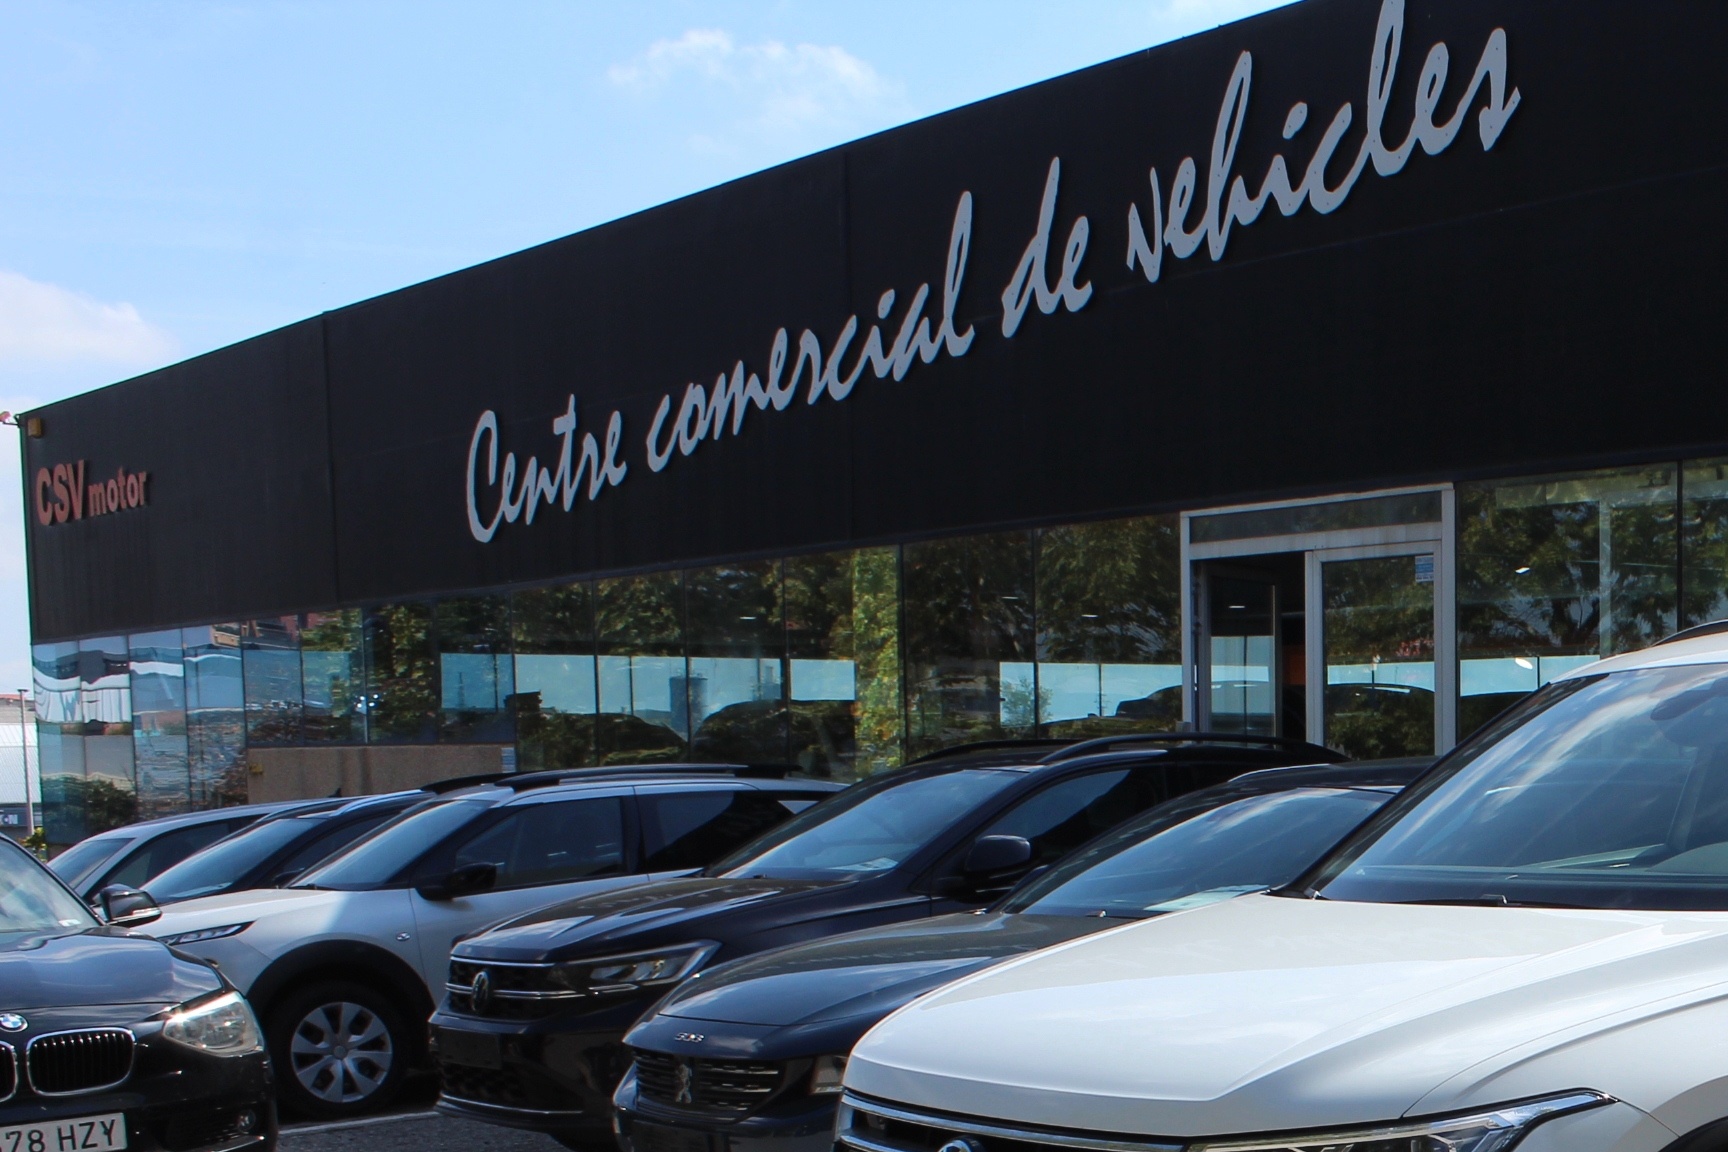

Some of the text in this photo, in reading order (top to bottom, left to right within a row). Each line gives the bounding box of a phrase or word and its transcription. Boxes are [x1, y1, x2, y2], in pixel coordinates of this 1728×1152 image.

[467, 0, 1522, 543] Centre comercial de vehicles
[36, 459, 147, 526] CSV motor
[57, 1118, 116, 1152] HZY
